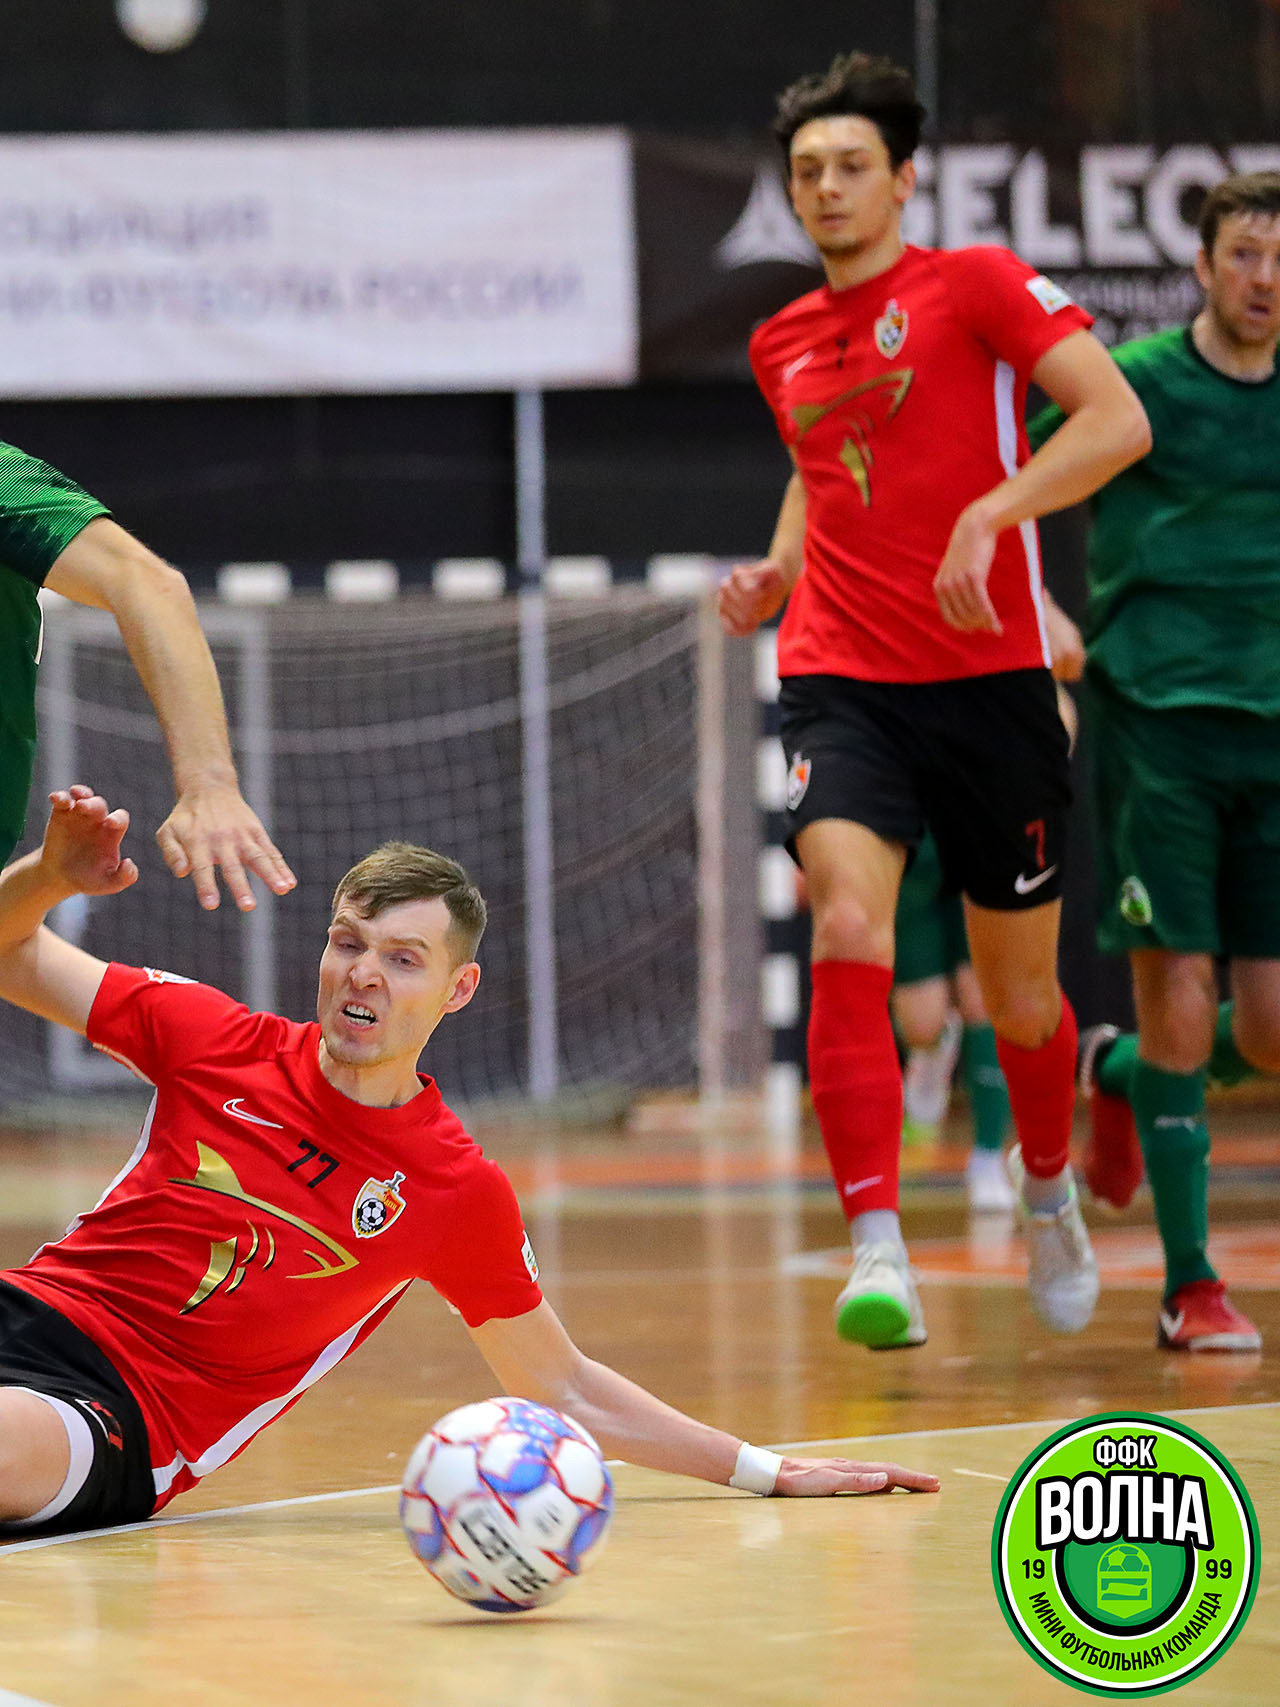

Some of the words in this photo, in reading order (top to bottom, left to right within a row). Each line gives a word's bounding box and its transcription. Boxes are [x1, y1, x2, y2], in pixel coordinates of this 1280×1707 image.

[900, 143, 1280, 267] ELEC
[1025, 819, 1045, 869] 7
[286, 1138, 340, 1190] 77
